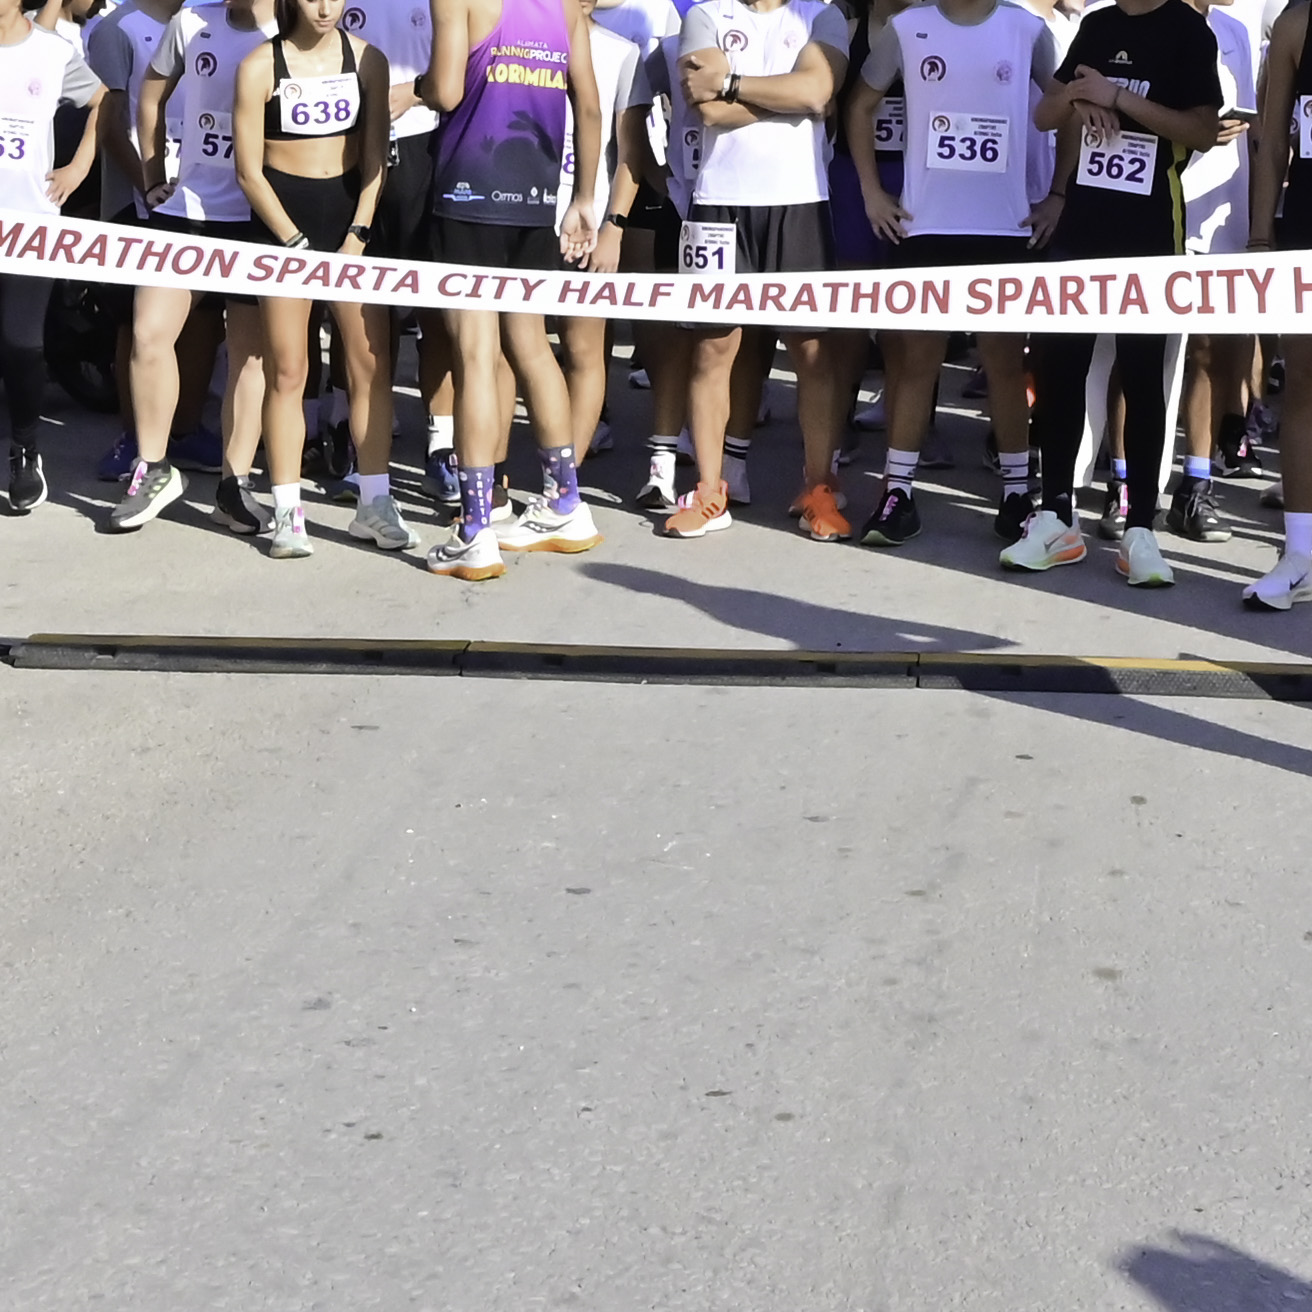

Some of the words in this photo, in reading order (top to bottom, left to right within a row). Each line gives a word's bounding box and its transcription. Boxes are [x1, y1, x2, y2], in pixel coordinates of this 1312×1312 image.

[291, 98, 351, 126] 638
[874, 119, 902, 143] 57
[201, 133, 234, 160] 57
[936, 135, 1000, 163] 536
[1086, 151, 1147, 184] 562
[682, 244, 725, 270] 651
[247, 255, 420, 294] SPARTA
[438, 273, 546, 302] CITY
[557, 280, 675, 308] HALF
[687, 279, 951, 315] MARATHON
[967, 274, 1149, 315] SPARTA
[1164, 267, 1275, 315] CITY
